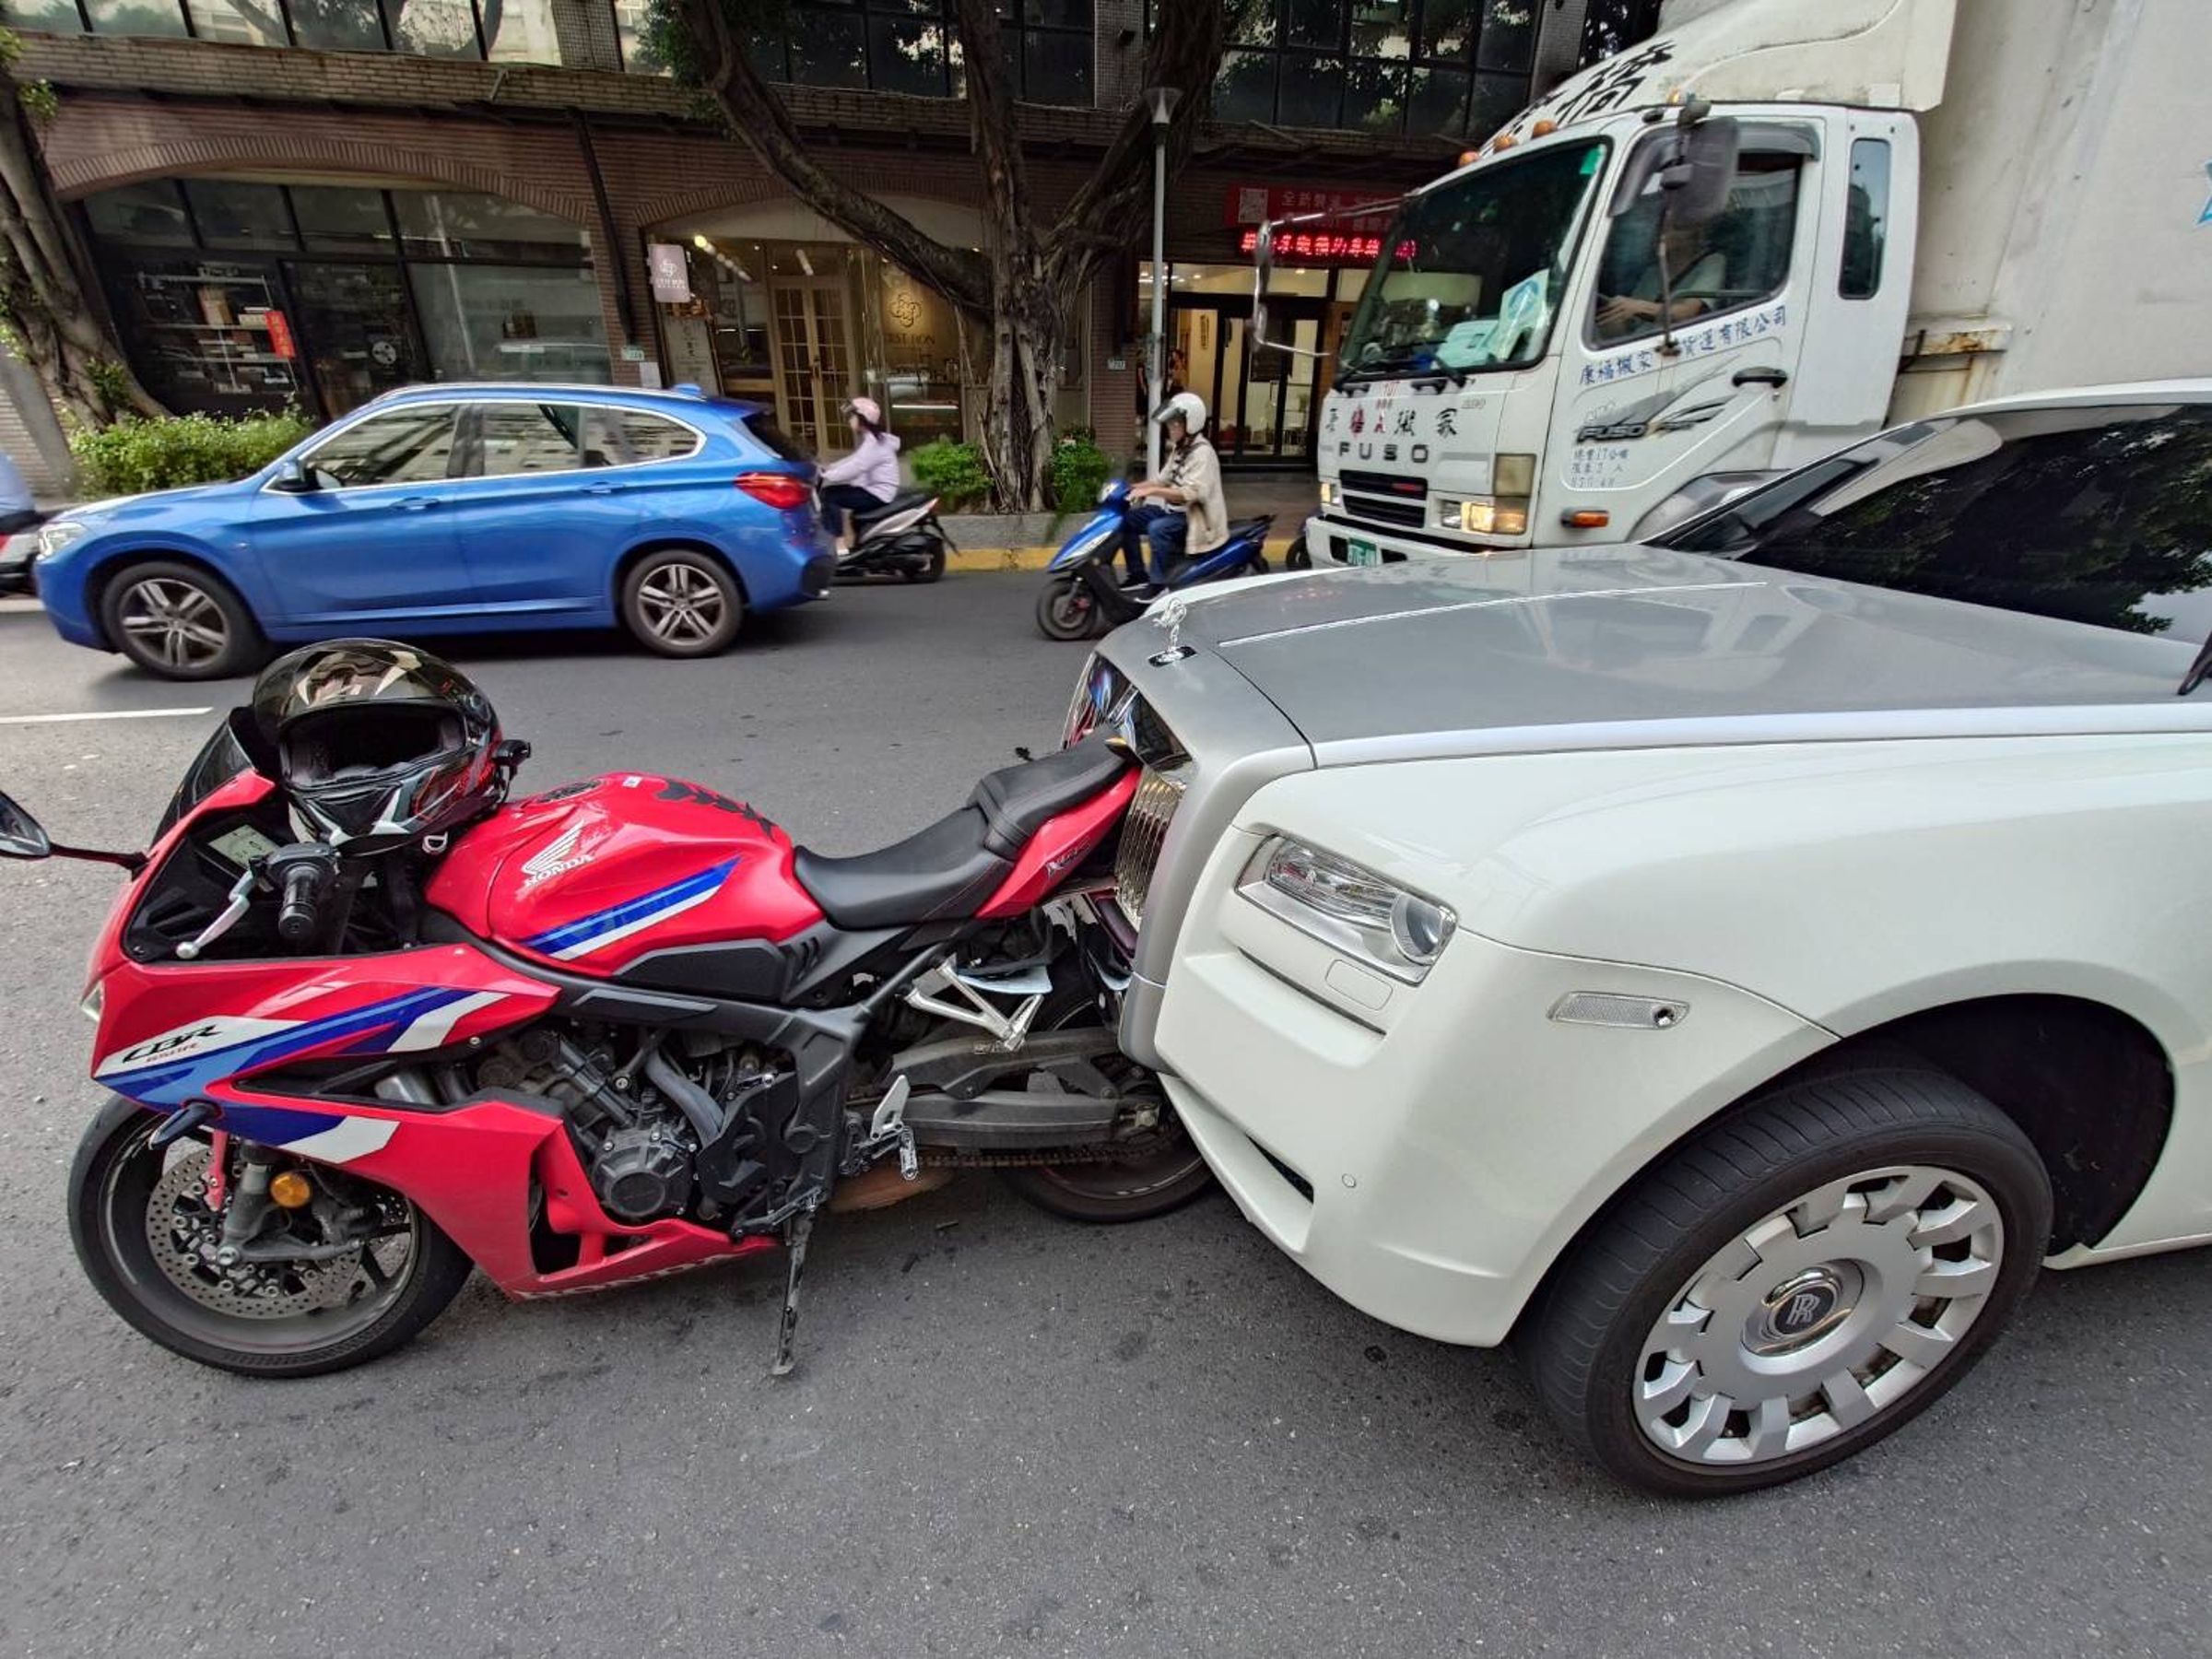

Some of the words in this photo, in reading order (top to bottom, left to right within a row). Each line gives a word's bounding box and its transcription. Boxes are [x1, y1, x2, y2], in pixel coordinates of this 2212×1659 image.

[1577, 424, 1649, 442] FUSO
[1339, 441, 1429, 464] FUSO
[524, 853, 595, 888] HONDA
[122, 1024, 222, 1064] CBR
